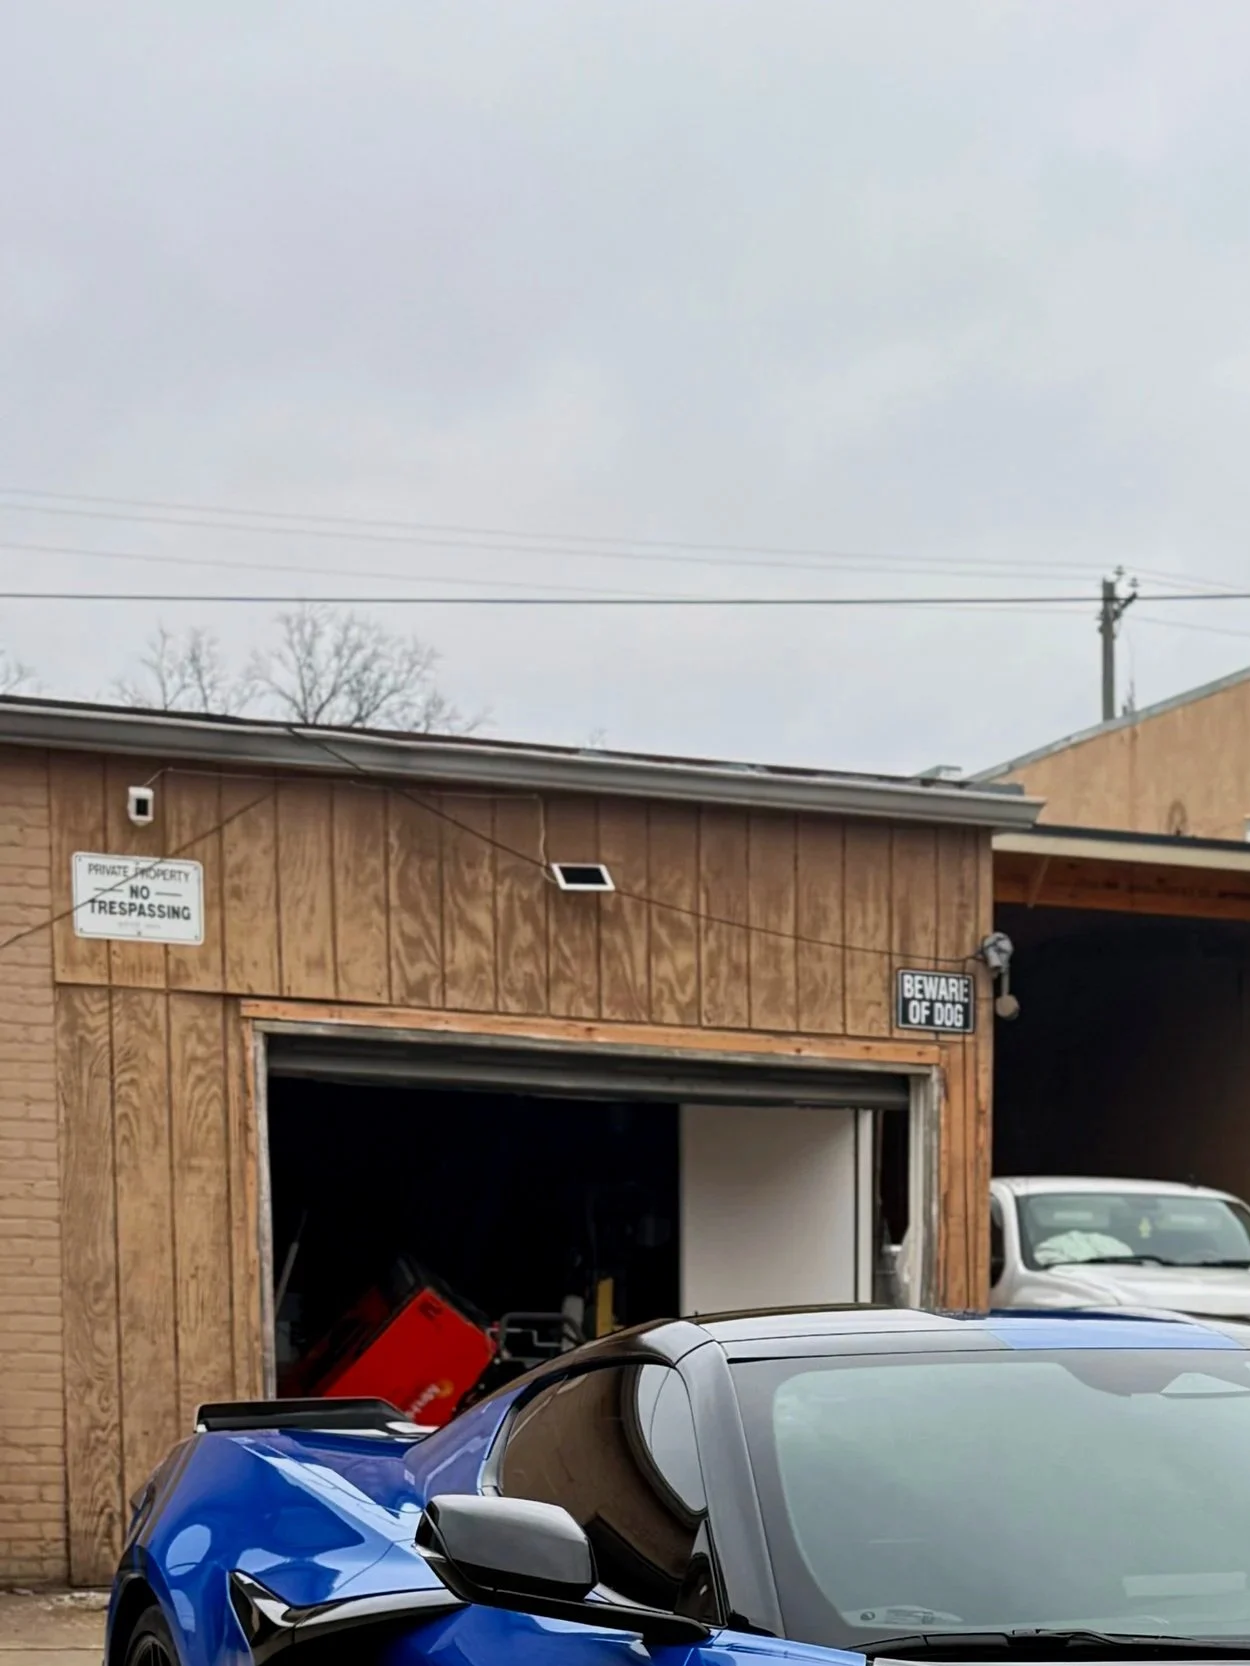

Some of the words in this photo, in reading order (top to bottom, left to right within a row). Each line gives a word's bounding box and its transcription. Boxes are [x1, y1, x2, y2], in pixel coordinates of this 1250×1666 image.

[87, 862, 129, 877] PRIVATE
[134, 866, 191, 883] PROPERTY
[129, 884, 150, 900] NO
[89, 899, 192, 921] TRESPASSING
[902, 974, 969, 1003] BEWARE
[908, 1000, 931, 1025] OF
[933, 1002, 964, 1027] DOG
